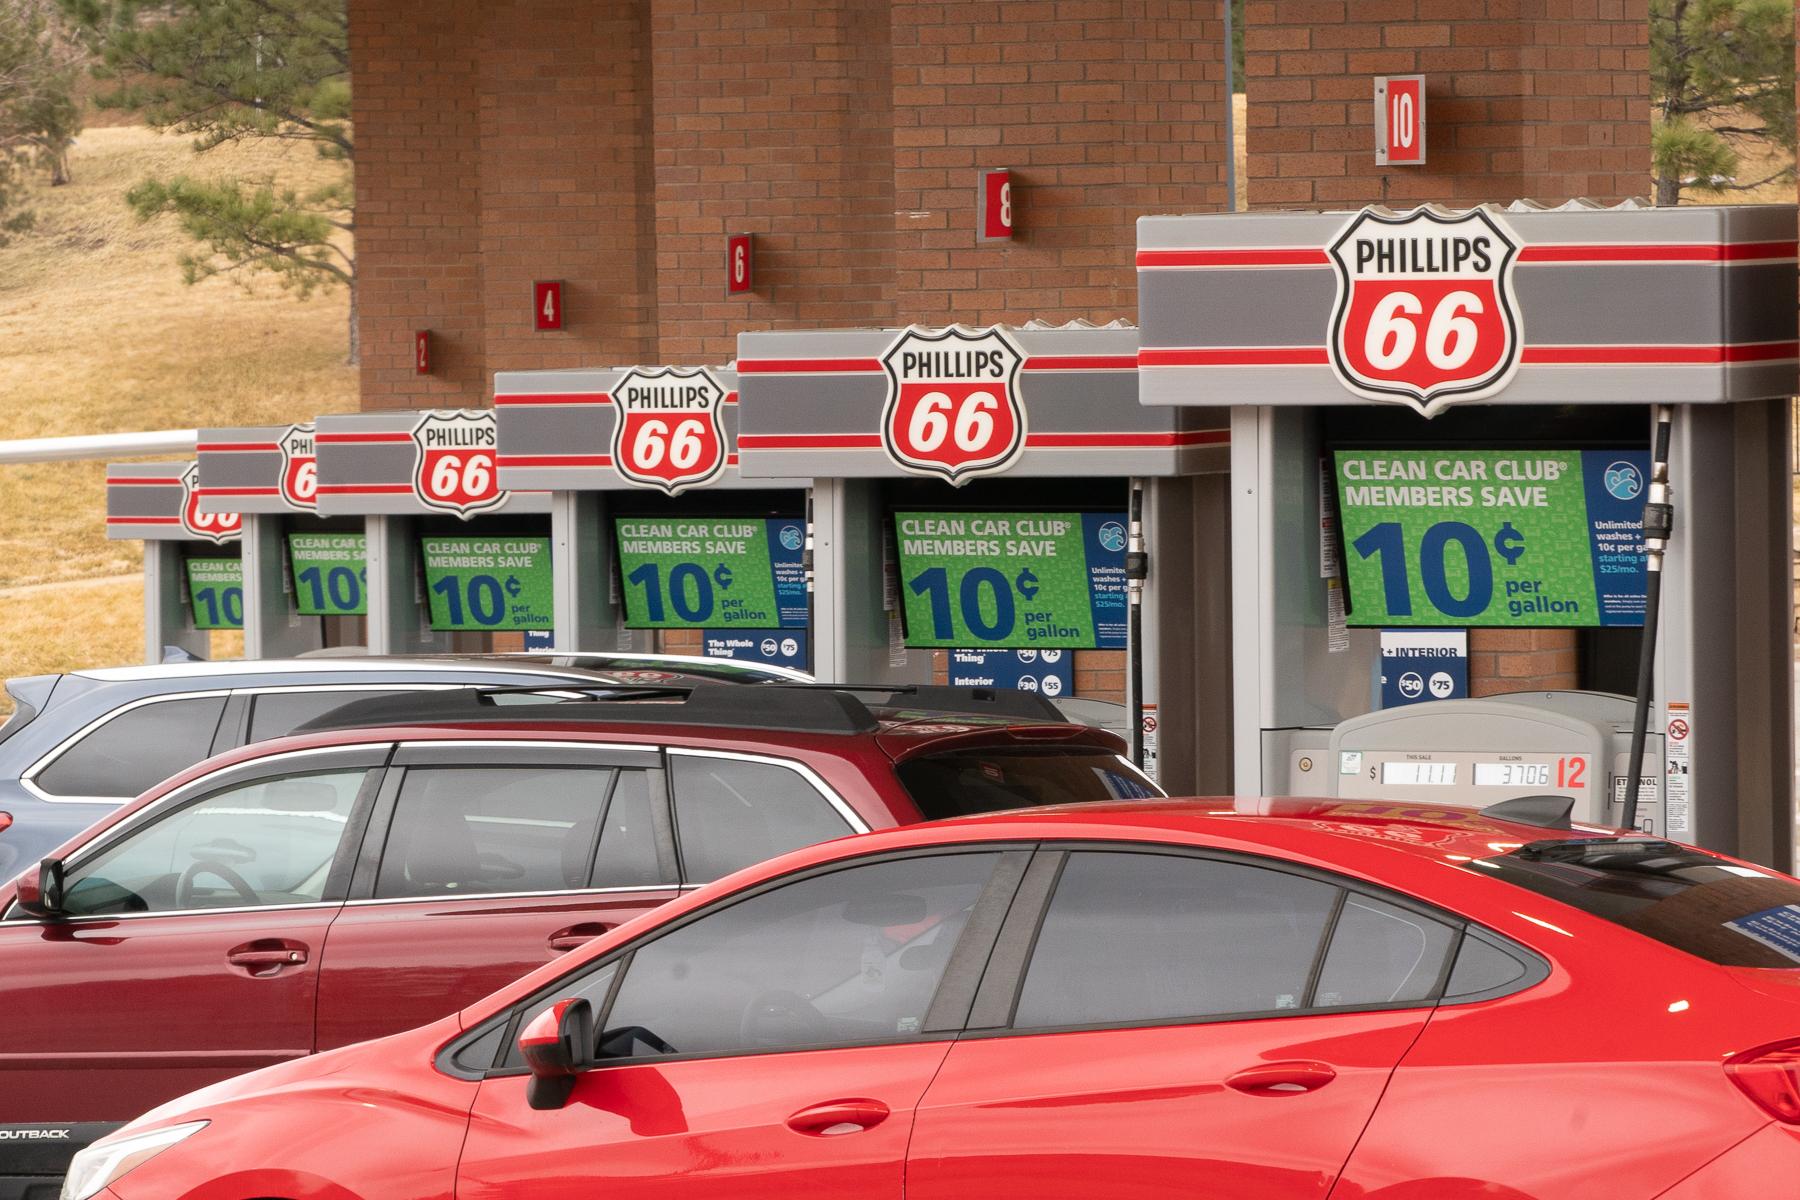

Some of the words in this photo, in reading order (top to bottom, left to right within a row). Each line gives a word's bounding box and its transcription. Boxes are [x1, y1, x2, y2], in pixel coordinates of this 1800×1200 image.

[1393, 92, 1413, 148] 10
[1000, 182, 1011, 227] 8
[1356, 235, 1491, 274] PHILLIPS
[735, 245, 744, 283] 6
[543, 290, 555, 322] 4
[1364, 290, 1484, 371] 66
[419, 338, 426, 368] 2
[903, 350, 1004, 379] PHILLIPS
[627, 385, 710, 409] PHILLIPS
[907, 391, 998, 453] 66
[426, 427, 495, 446] PHILLIPS
[632, 419, 705, 470] 66
[431, 454, 492, 497] 66
[1343, 460, 1429, 481] CLEAN
[1434, 460, 1488, 481] CAR
[1346, 486, 1473, 507] MEMBERS
[1481, 486, 1549, 507] SAVE
[621, 524, 673, 538] CLEAN
[677, 524, 708, 538] CAR
[901, 519, 965, 537] CLEAN
[971, 519, 1010, 536] CAR
[1595, 520, 1643, 530] Unlimited
[293, 538, 330, 548] CLEAN
[332, 538, 355, 548] CAR
[1596, 532, 1633, 541] washes
[426, 542, 470, 554] CLEAN
[473, 542, 500, 554] CAR
[623, 541, 701, 554] MEMBERS
[705, 541, 746, 554] SAVE
[904, 540, 1000, 556] MEMBERS
[1006, 540, 1056, 556] SAVE
[1617, 544, 1634, 553] per
[294, 550, 350, 560] MEMBERS
[351, 550, 367, 560] SA
[429, 556, 494, 568] MEMBERS
[497, 556, 533, 568] SAVE
[1598, 553, 1637, 564] starting
[190, 562, 224, 571] CLEAN
[191, 572, 242, 581] MEMBERS
[1092, 575, 1121, 583] washes
[1108, 585, 1122, 593] per
[1506, 579, 1542, 597] per
[195, 587, 243, 625] 10
[511, 604, 530, 615] per
[722, 598, 744, 610] per
[1509, 597, 1578, 617] gallon
[513, 614, 549, 625] gallon
[724, 608, 766, 621] gallon
[1024, 611, 1053, 625] per
[1027, 624, 1080, 641] gallon
[1396, 647, 1458, 657] INTERIOR
[954, 677, 994, 686] Interior
[1044, 682, 1059, 690] $55
[1401, 679, 1421, 691] $50
[1432, 679, 1450, 690] $75
[1369, 765, 1376, 780] $
[1557, 756, 1586, 788] 12
[1617, 778, 1658, 786] ETNOL
[0, 1129, 70, 1139] OUTBACK
